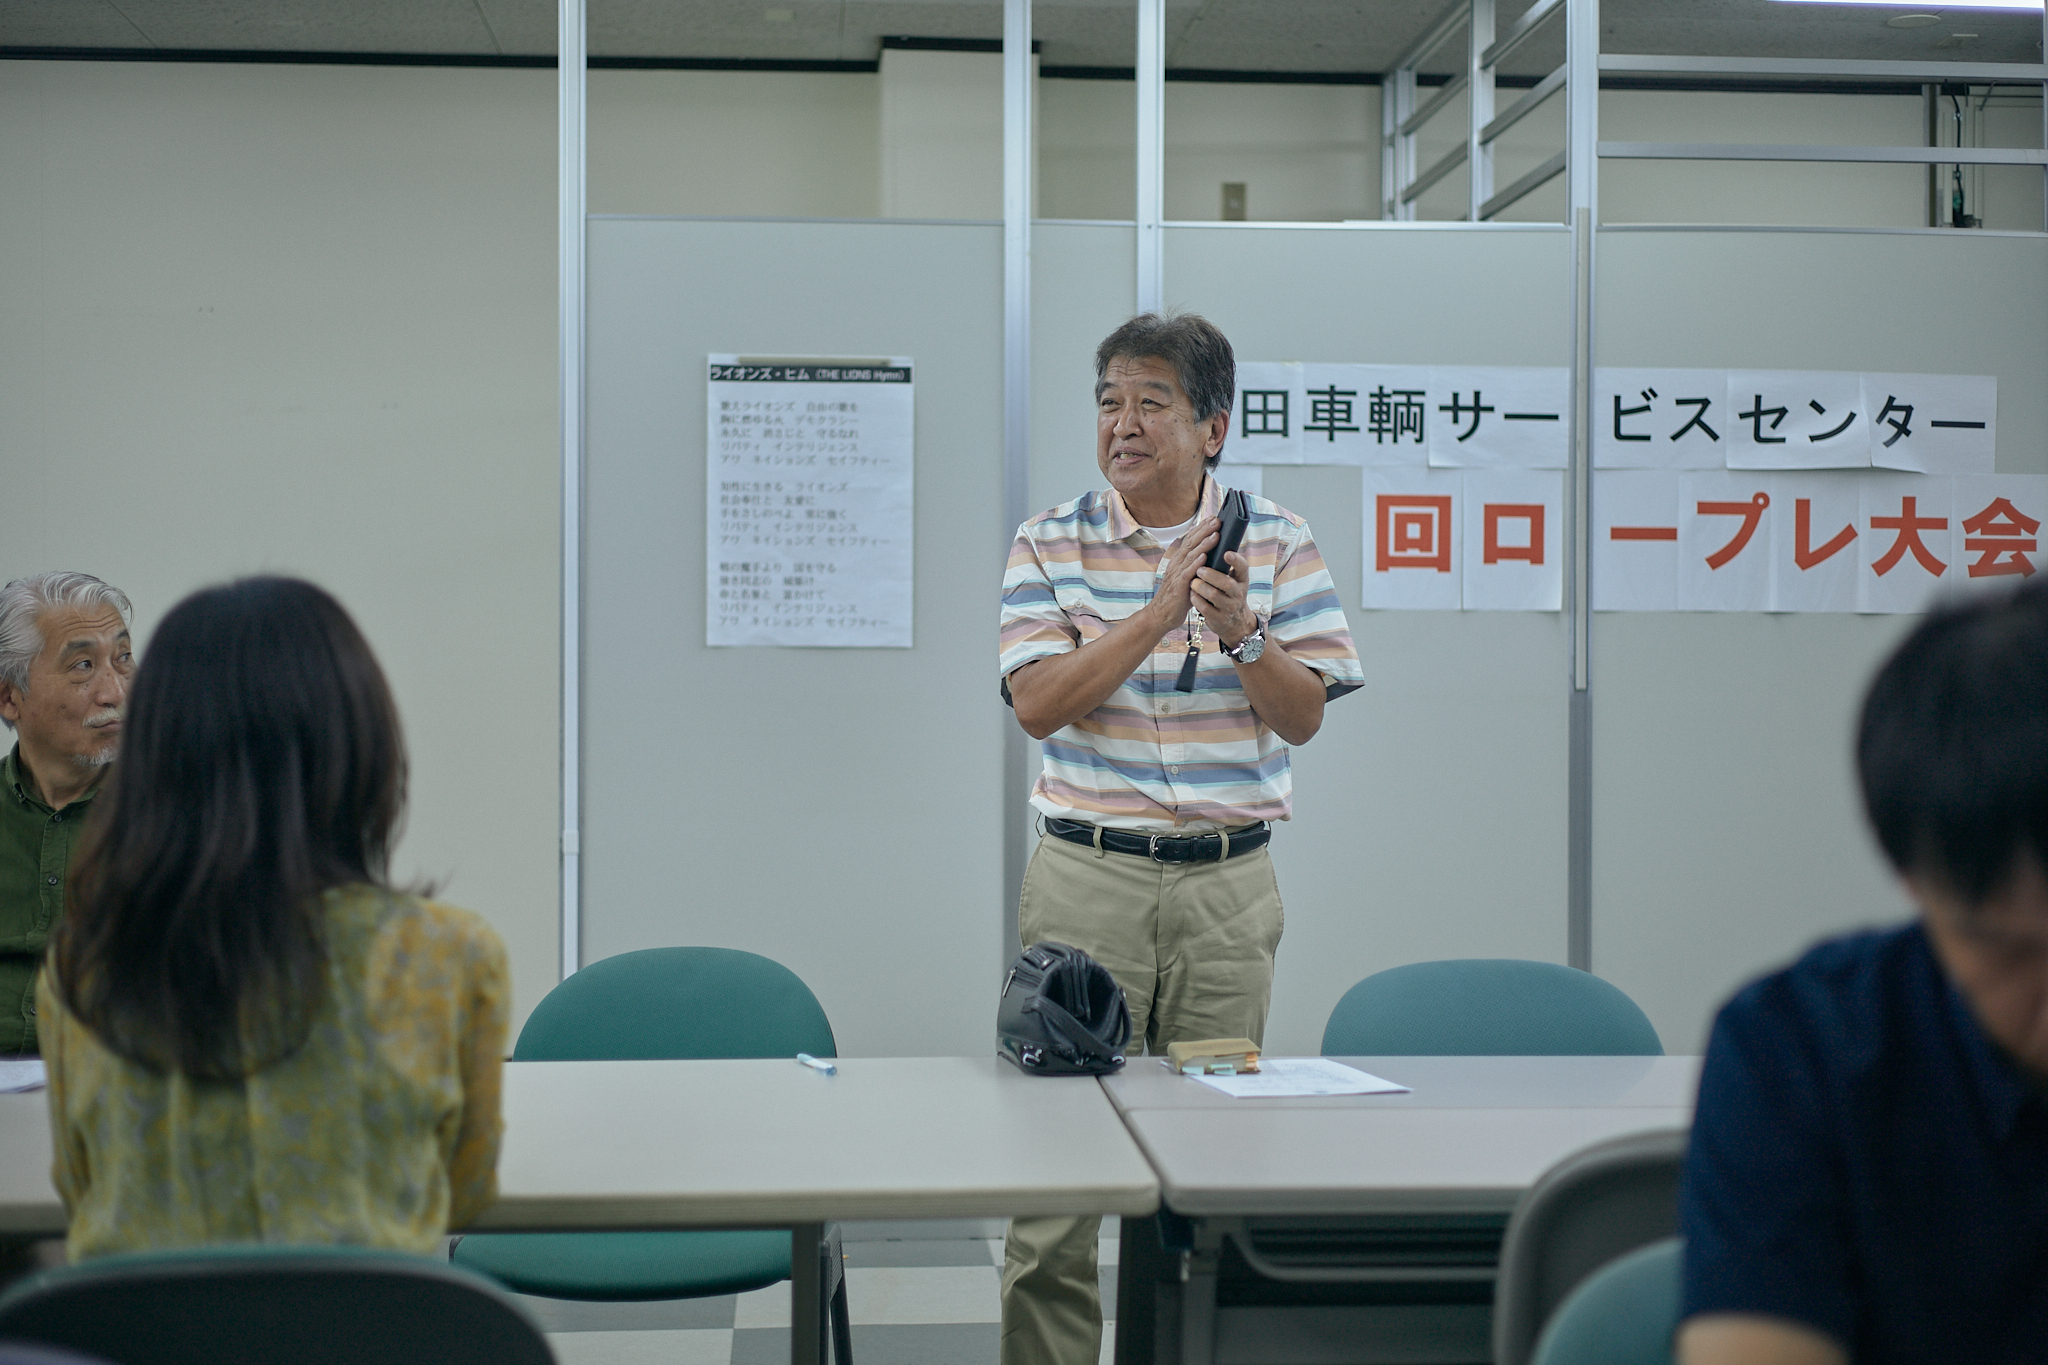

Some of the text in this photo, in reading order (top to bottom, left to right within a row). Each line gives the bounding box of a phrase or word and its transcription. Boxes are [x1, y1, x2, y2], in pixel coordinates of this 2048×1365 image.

[710, 366, 810, 381] ライオンズ・ヒム
[842, 368, 871, 381] LIONS
